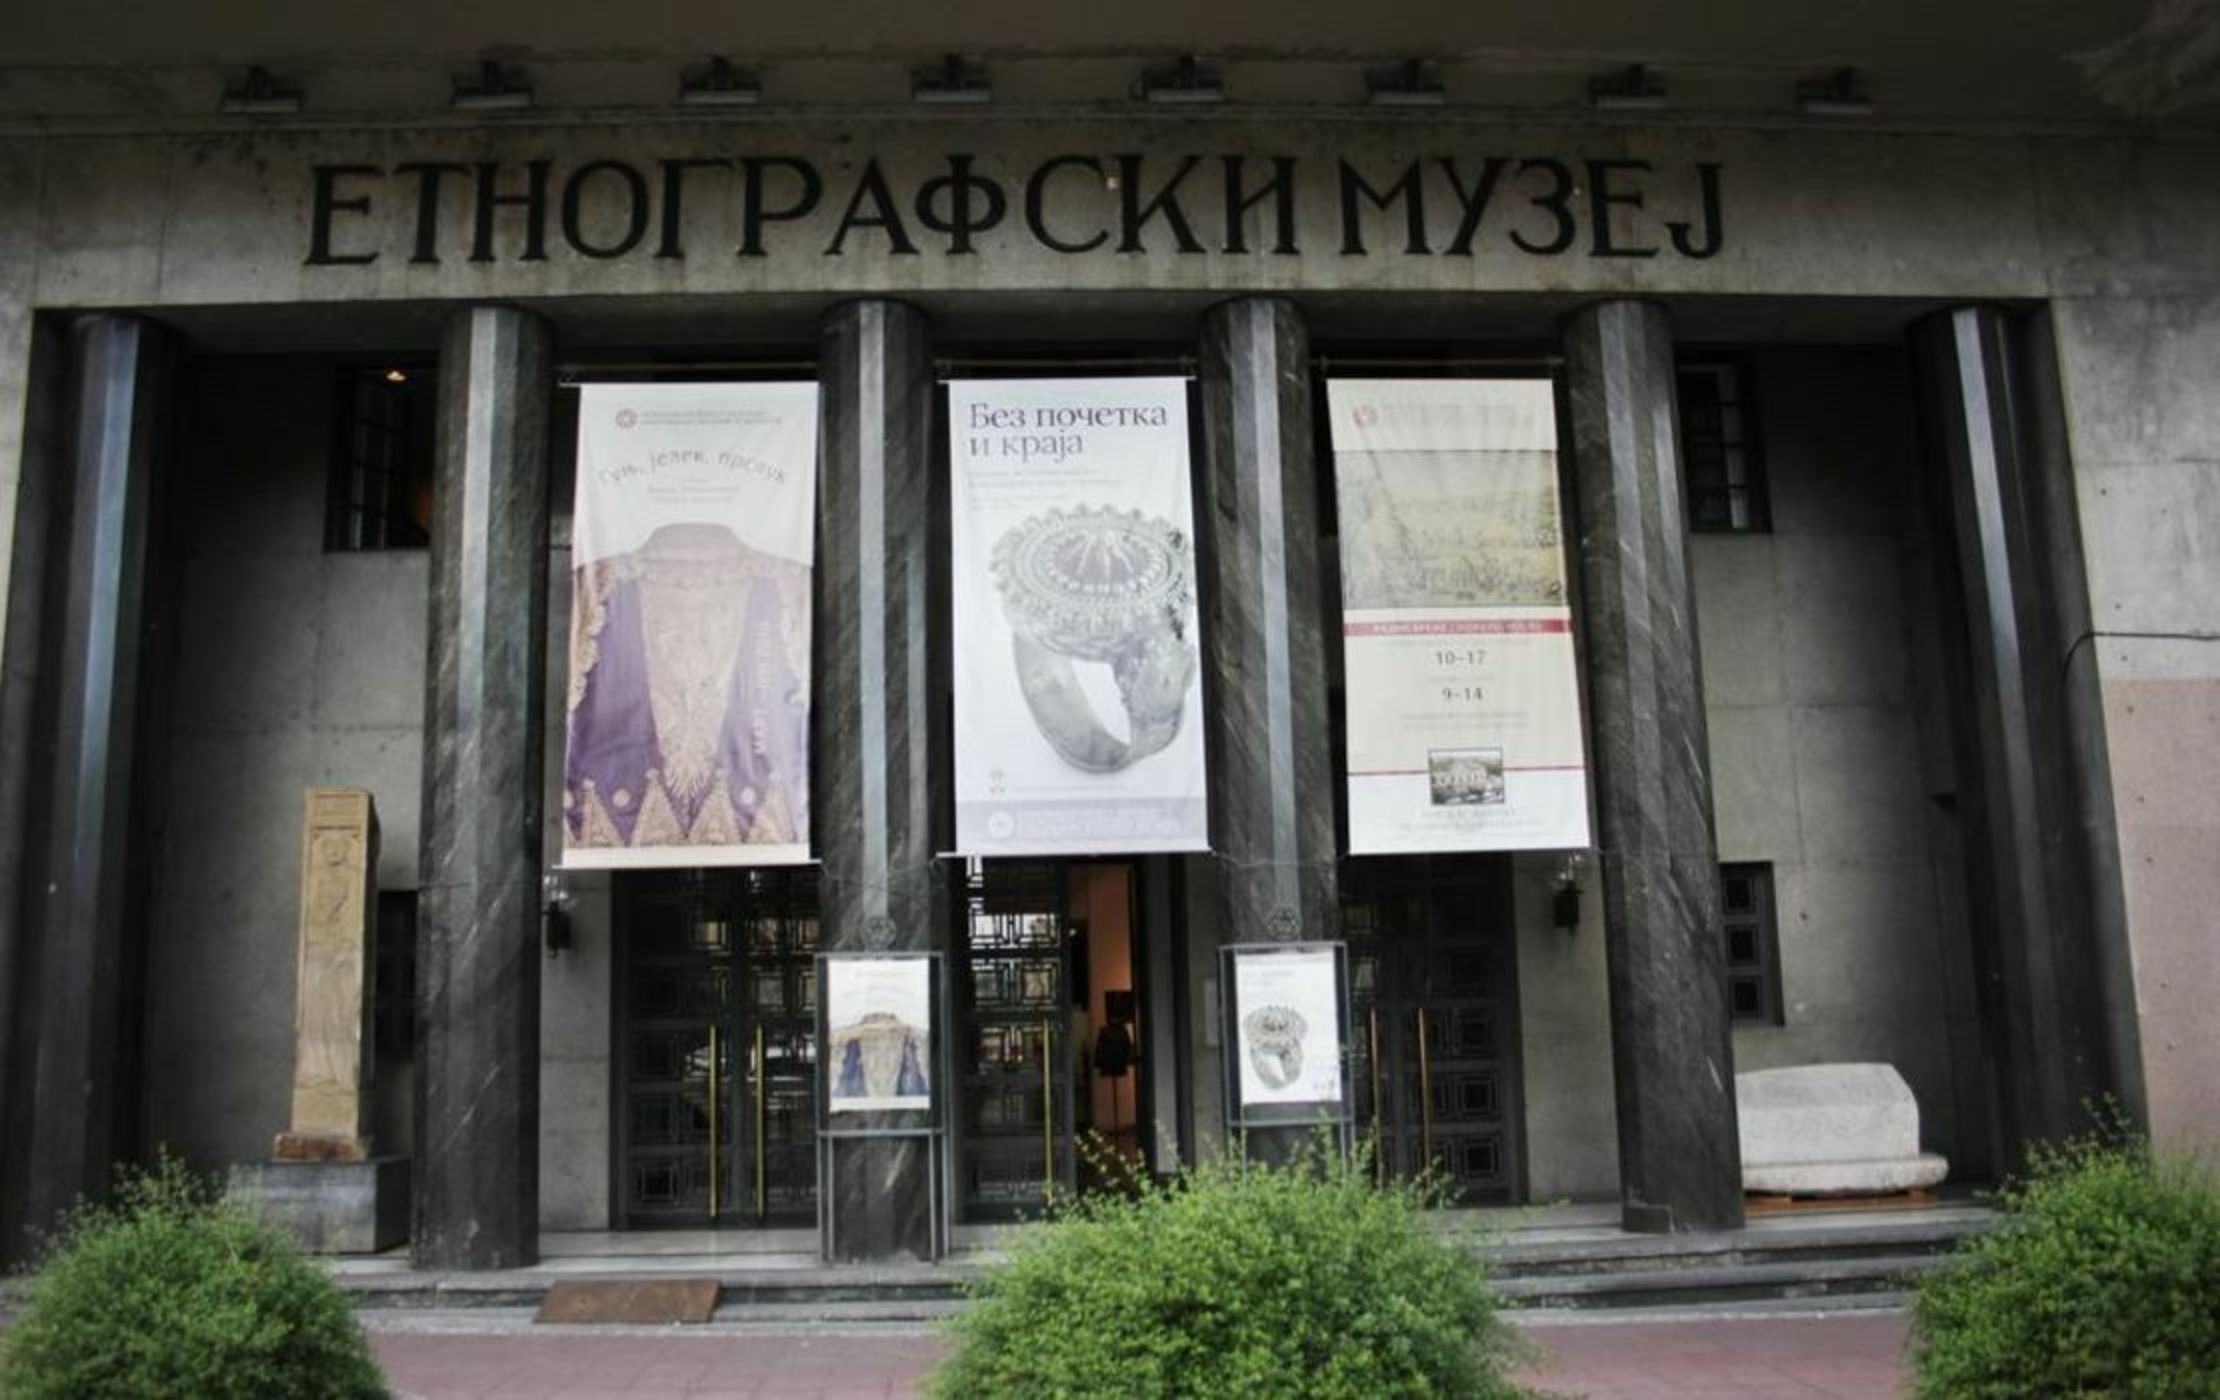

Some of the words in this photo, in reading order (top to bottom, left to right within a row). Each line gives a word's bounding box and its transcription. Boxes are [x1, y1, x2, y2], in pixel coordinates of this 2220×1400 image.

[303, 152, 1299, 266] ЕТНОГРАФСКИ
[1336, 156, 1724, 260] МУЗЕЈ
[969, 403, 1026, 429] Без
[1036, 405, 1168, 427] почетка
[969, 437, 989, 456] и
[1001, 429, 1084, 464] краја
